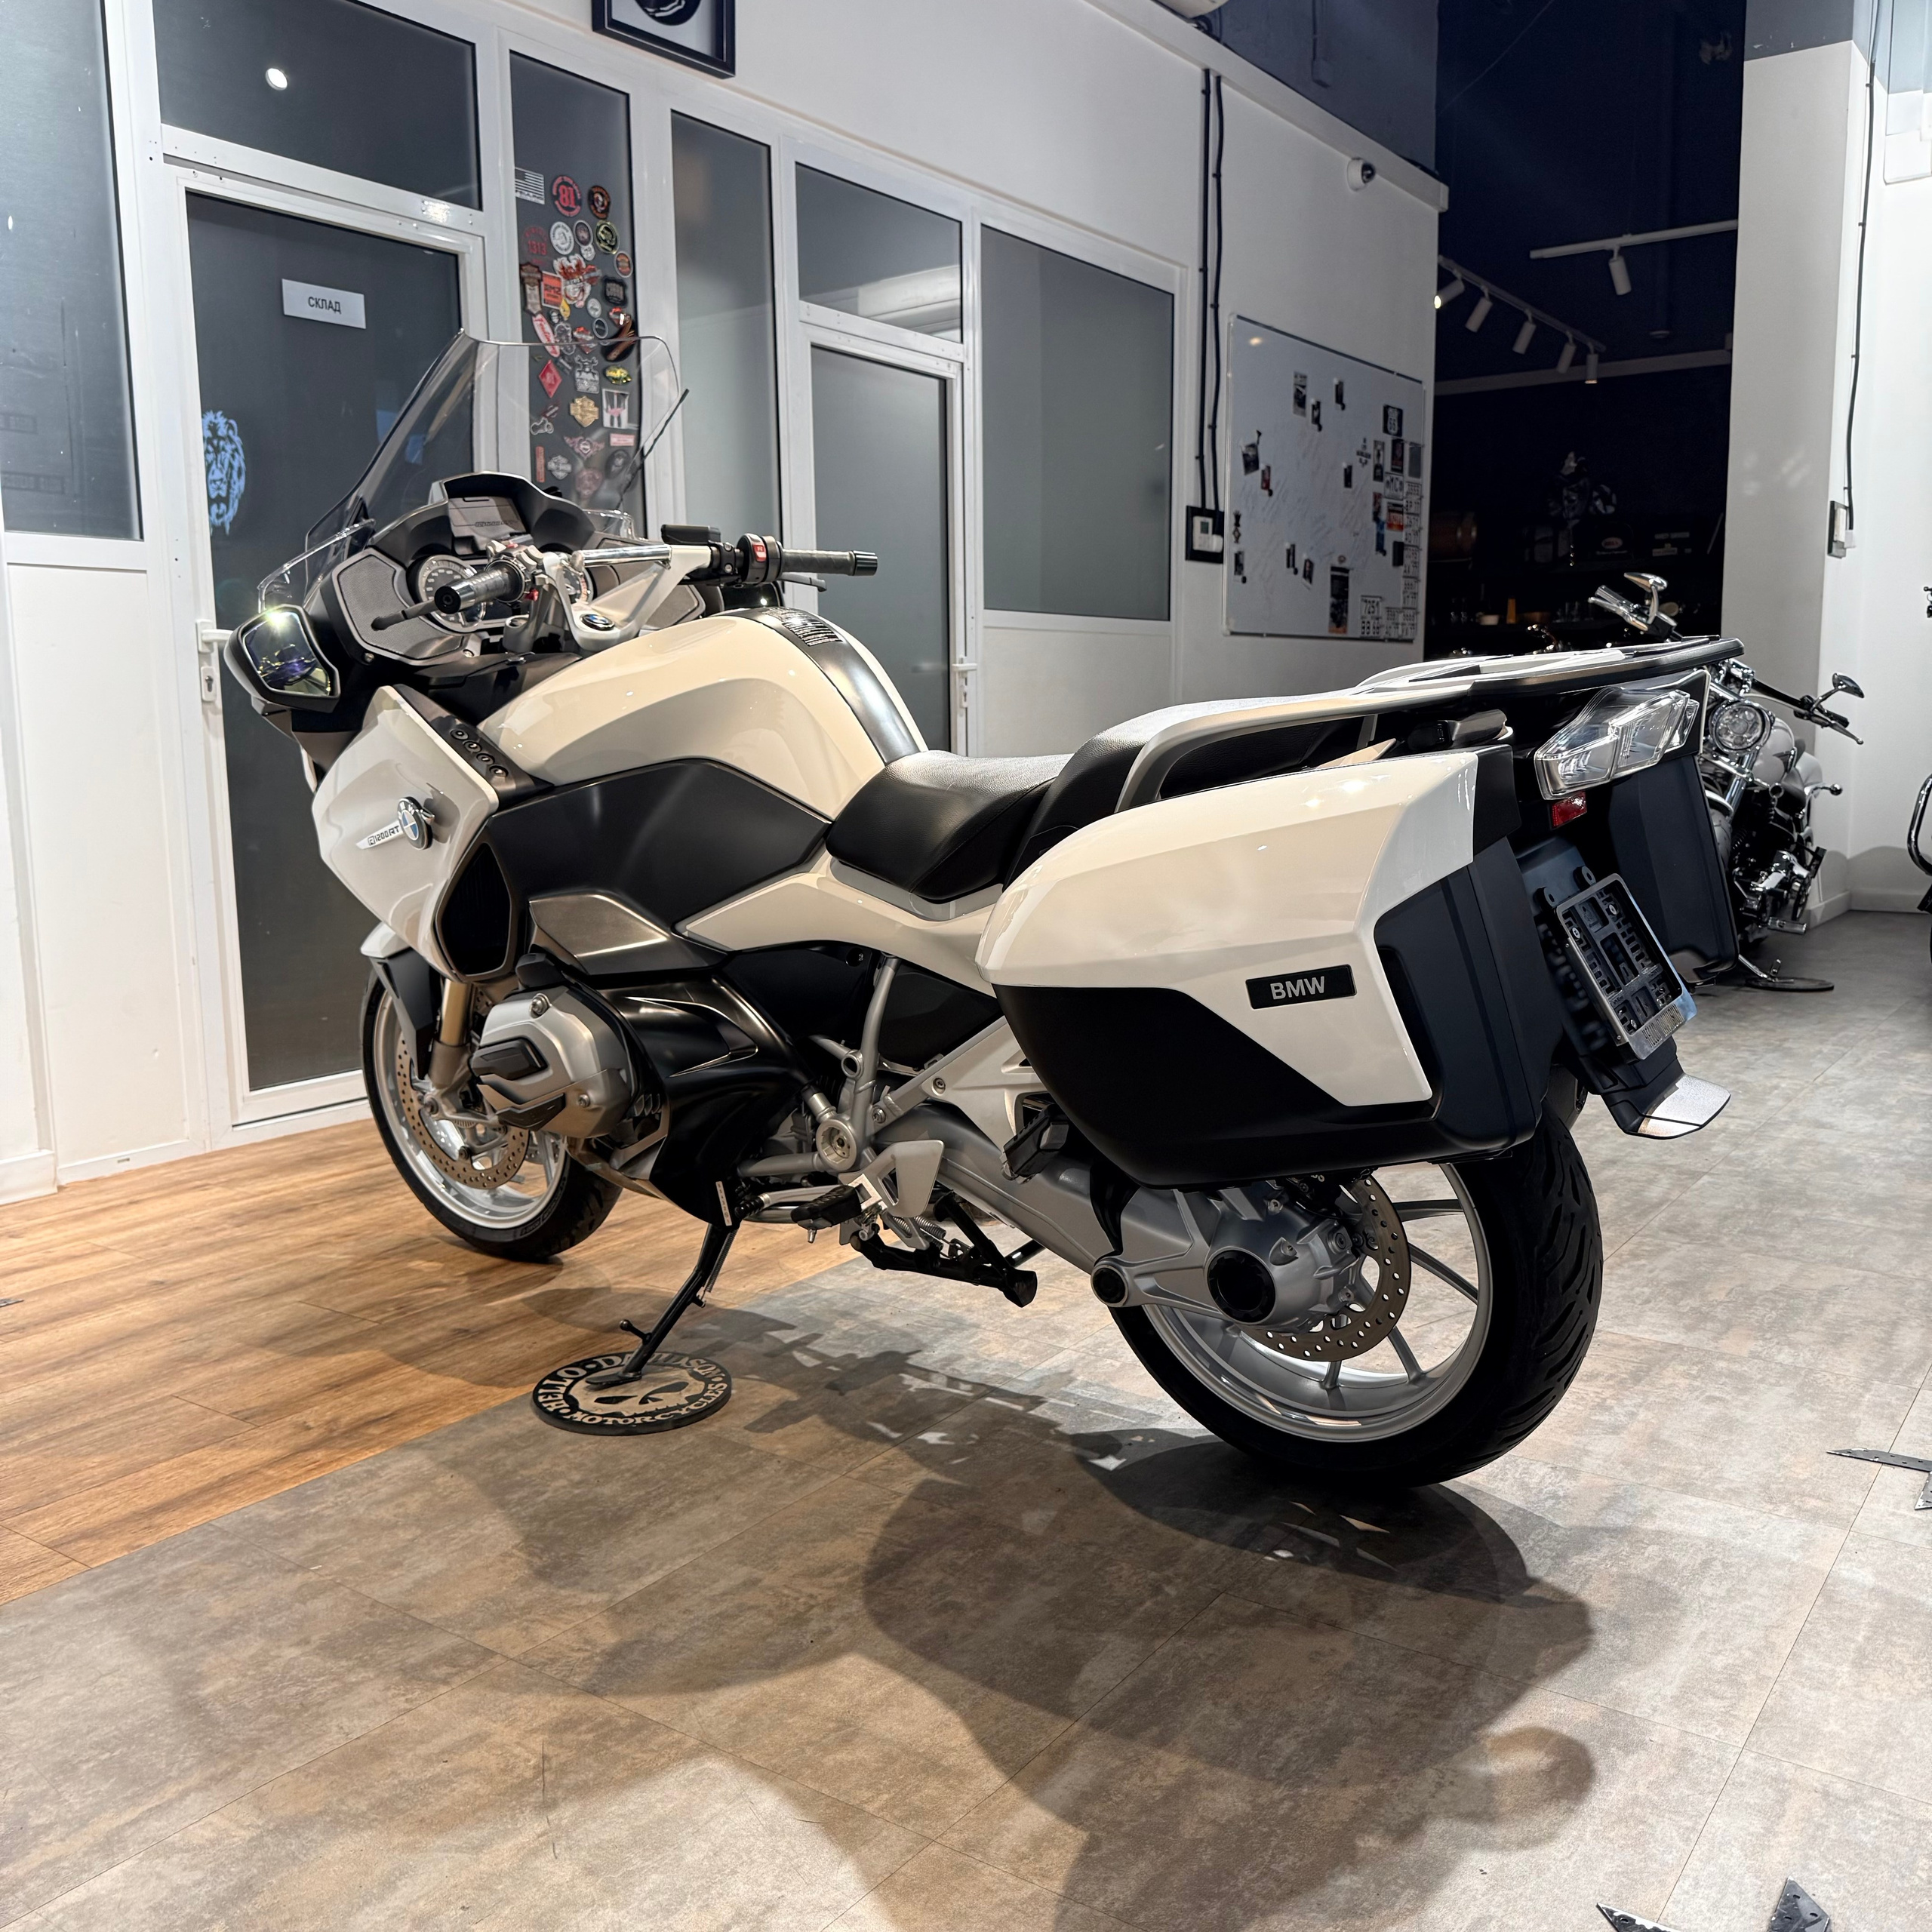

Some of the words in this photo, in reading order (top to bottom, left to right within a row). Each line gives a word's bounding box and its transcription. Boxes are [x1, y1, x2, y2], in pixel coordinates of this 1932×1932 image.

[558, 184, 576, 208] 81
[308, 296, 342, 314] СКЛАД
[1270, 976, 1324, 1000] BMW
[538, 1367, 587, 1412] HELLO
[565, 1383, 728, 1425] MOTORCYCLES
